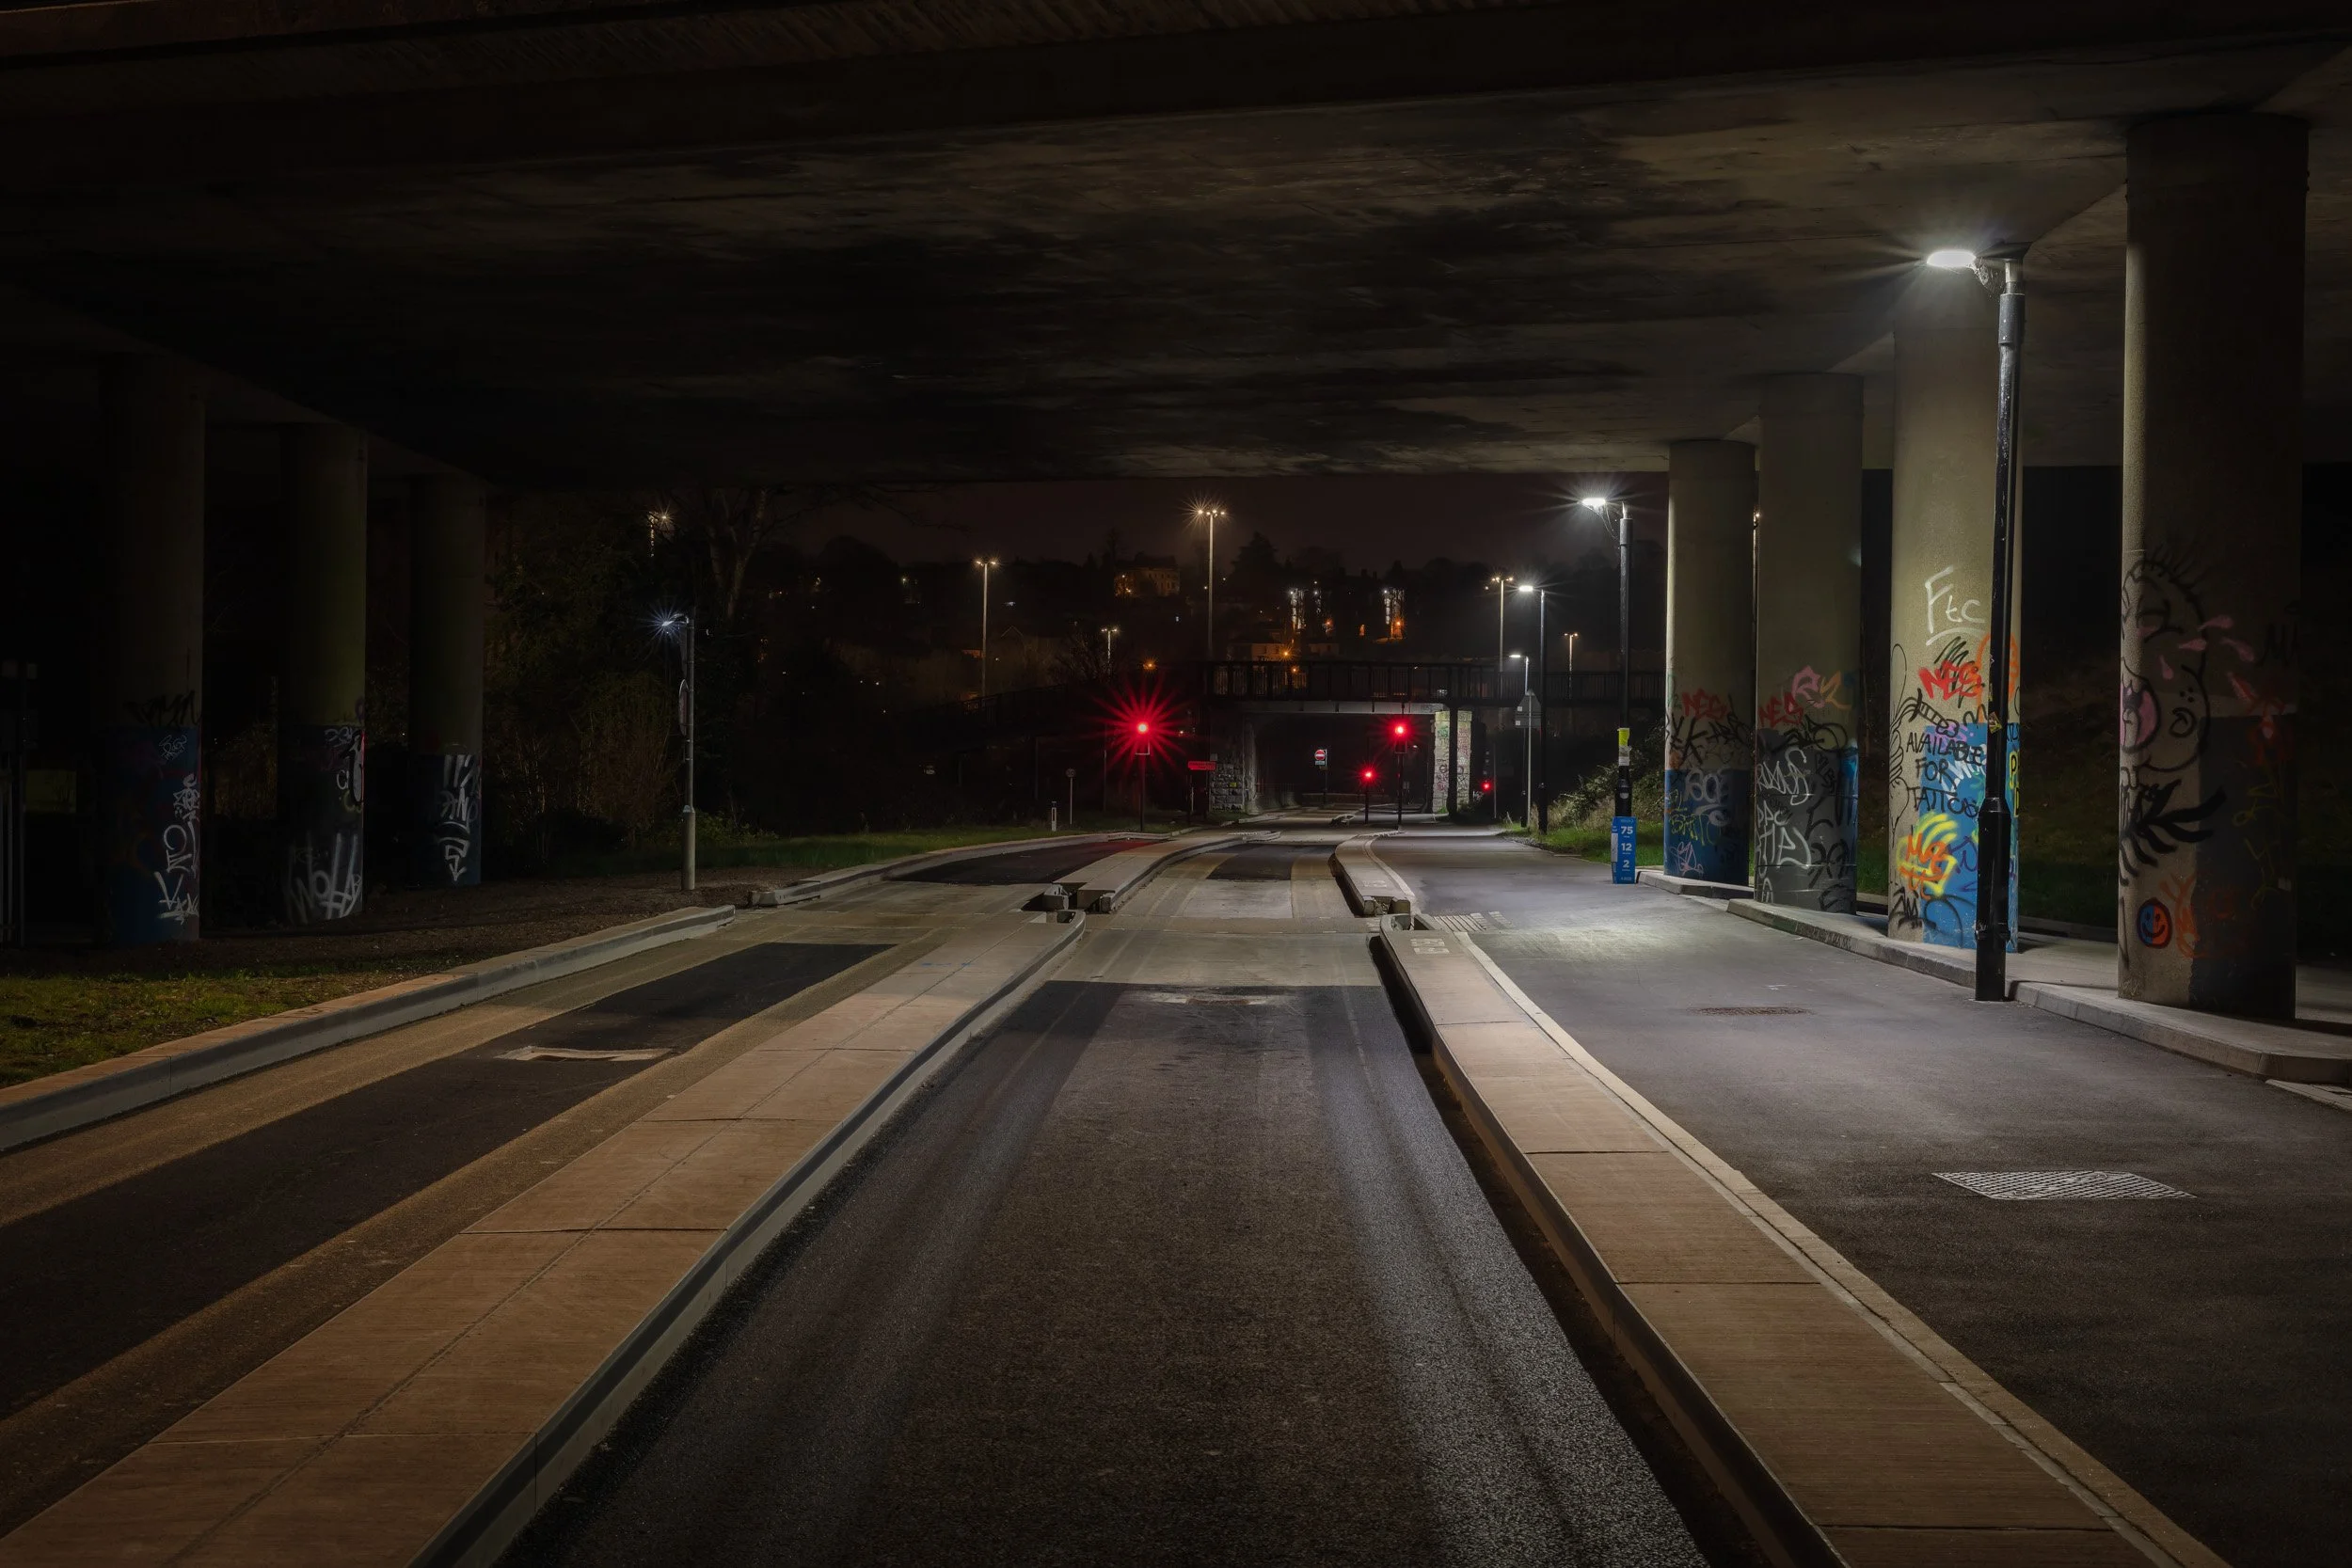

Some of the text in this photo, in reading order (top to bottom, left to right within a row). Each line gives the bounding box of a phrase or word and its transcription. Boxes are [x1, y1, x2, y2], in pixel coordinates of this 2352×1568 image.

[1915, 757, 1957, 789] FOR
[1620, 826, 1633, 834] 75
[1621, 843, 1632, 851] 12
